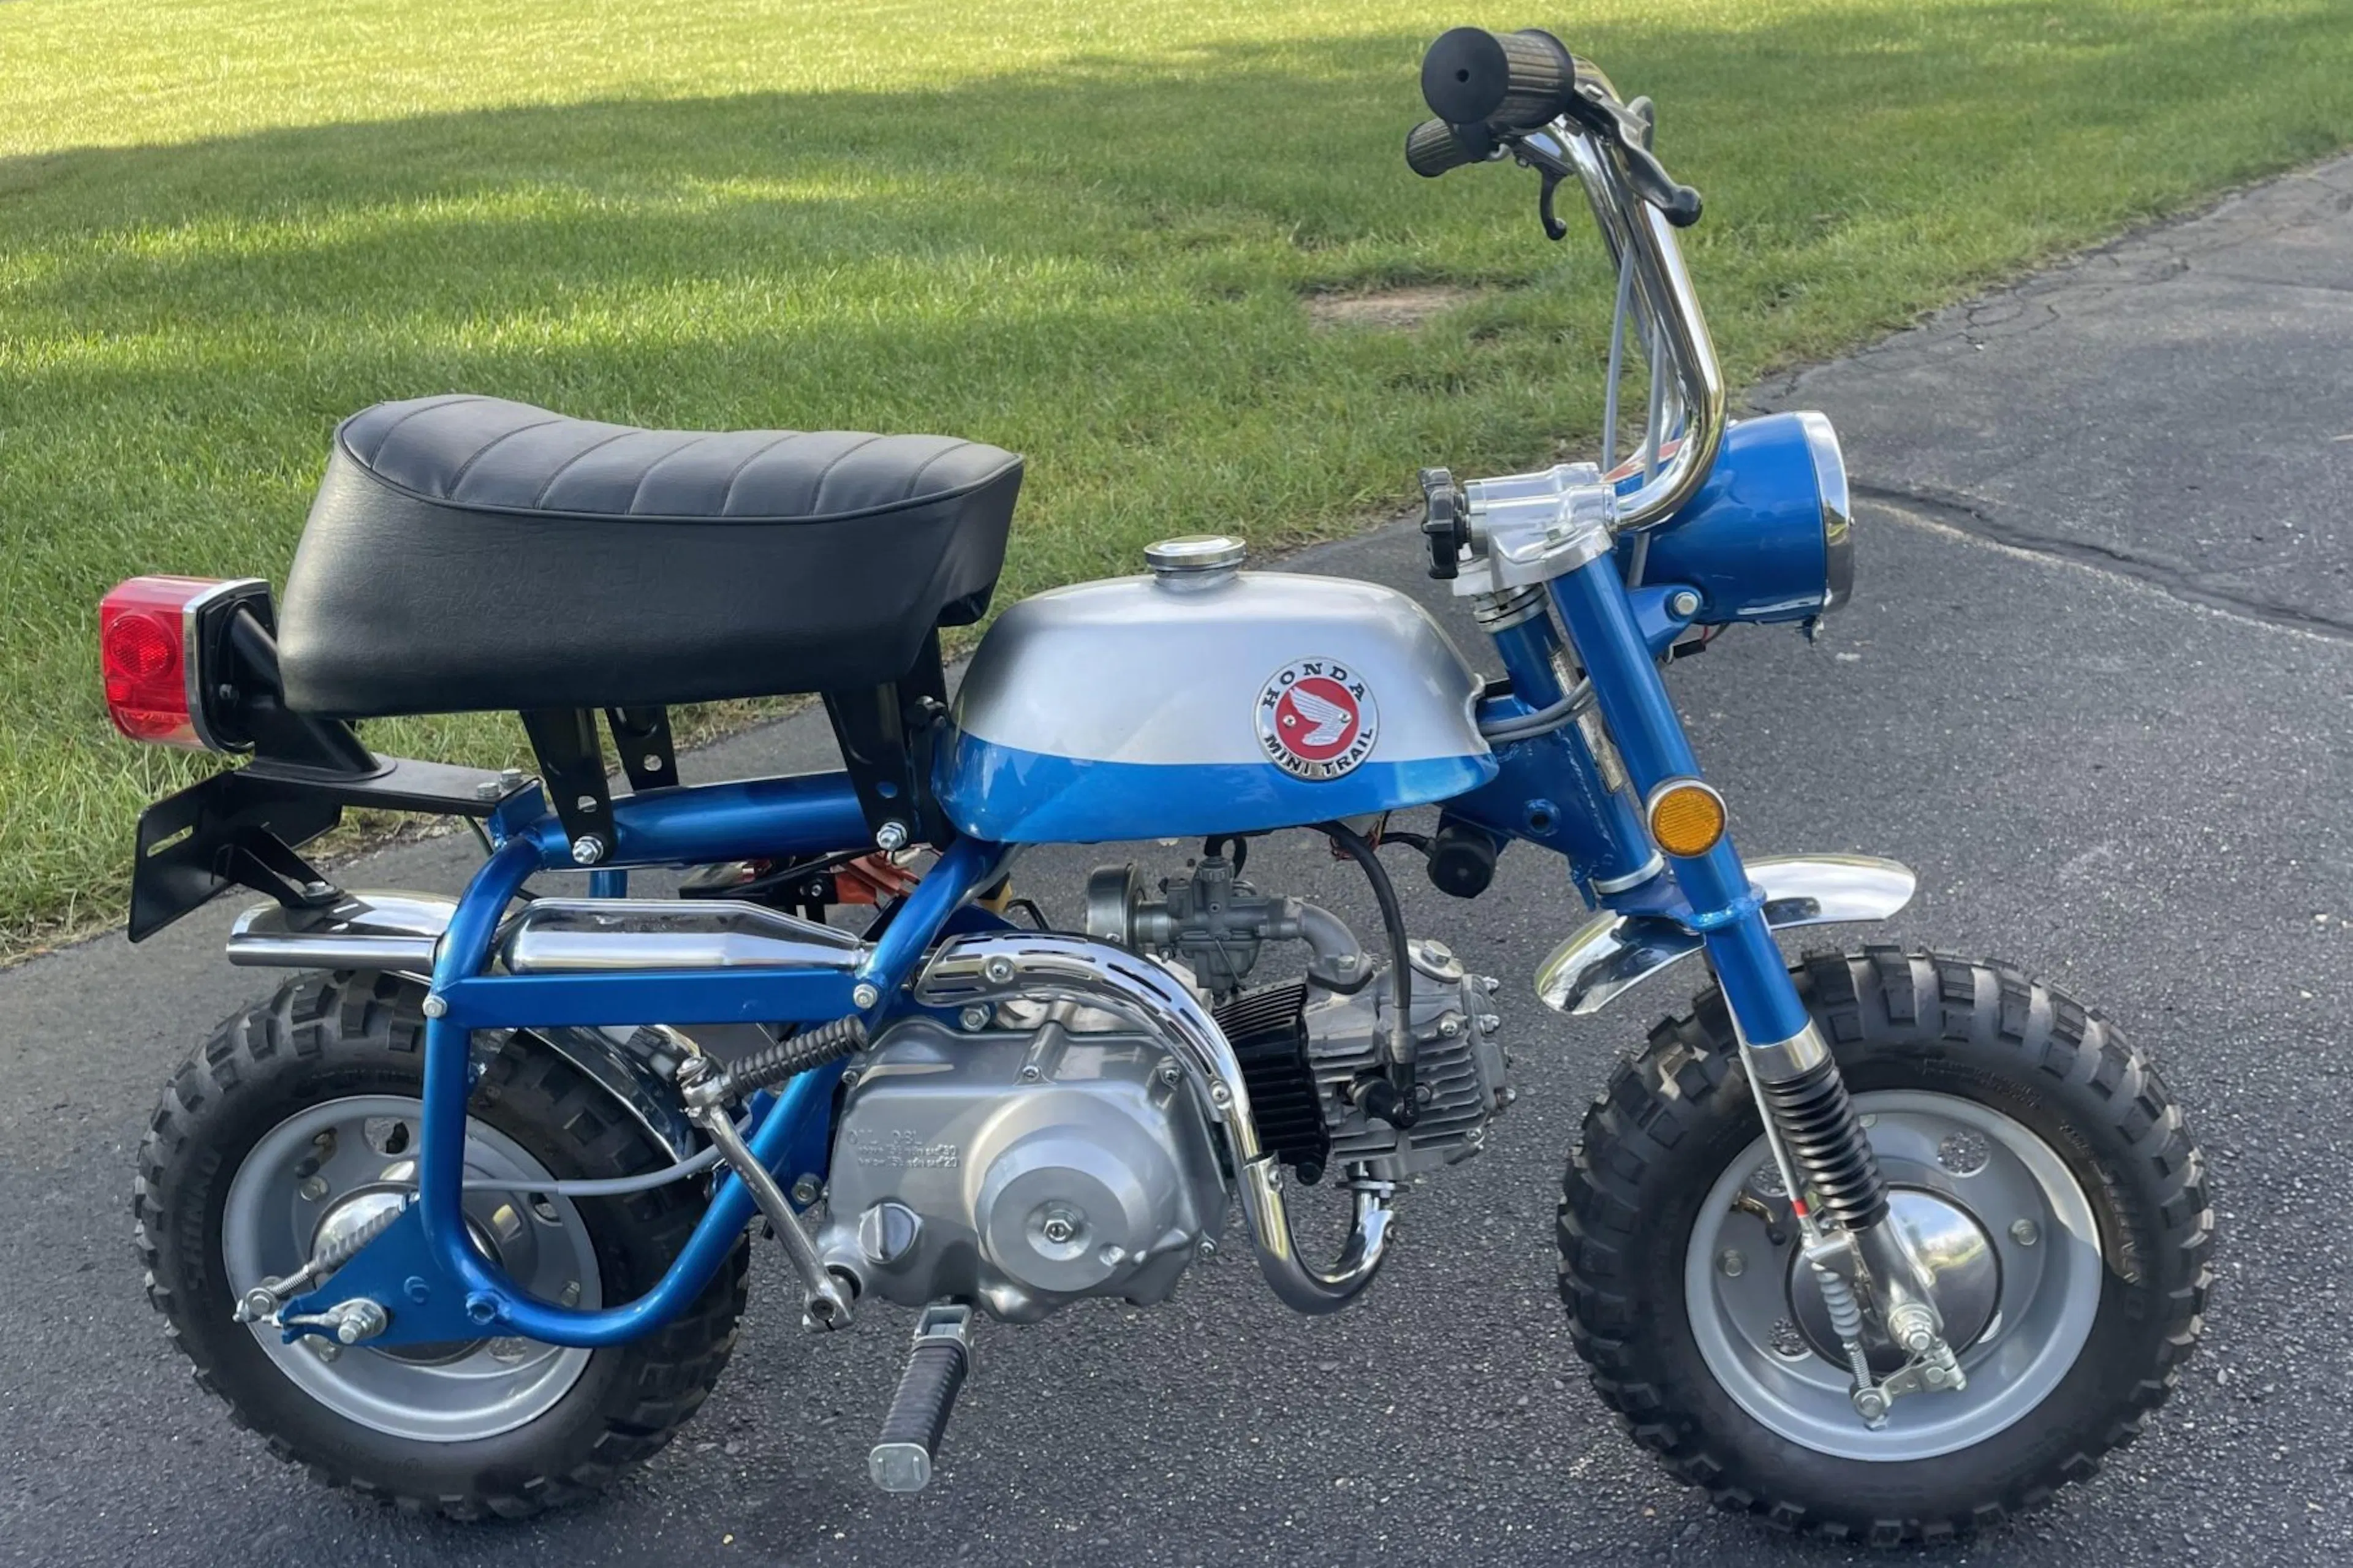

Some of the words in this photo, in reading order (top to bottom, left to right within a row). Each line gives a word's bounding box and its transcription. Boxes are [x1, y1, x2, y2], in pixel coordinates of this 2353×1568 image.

[1262, 662, 1365, 710] HONDA
[1264, 734, 1310, 775] MINI
[1320, 728, 1373, 775] TRAIL
